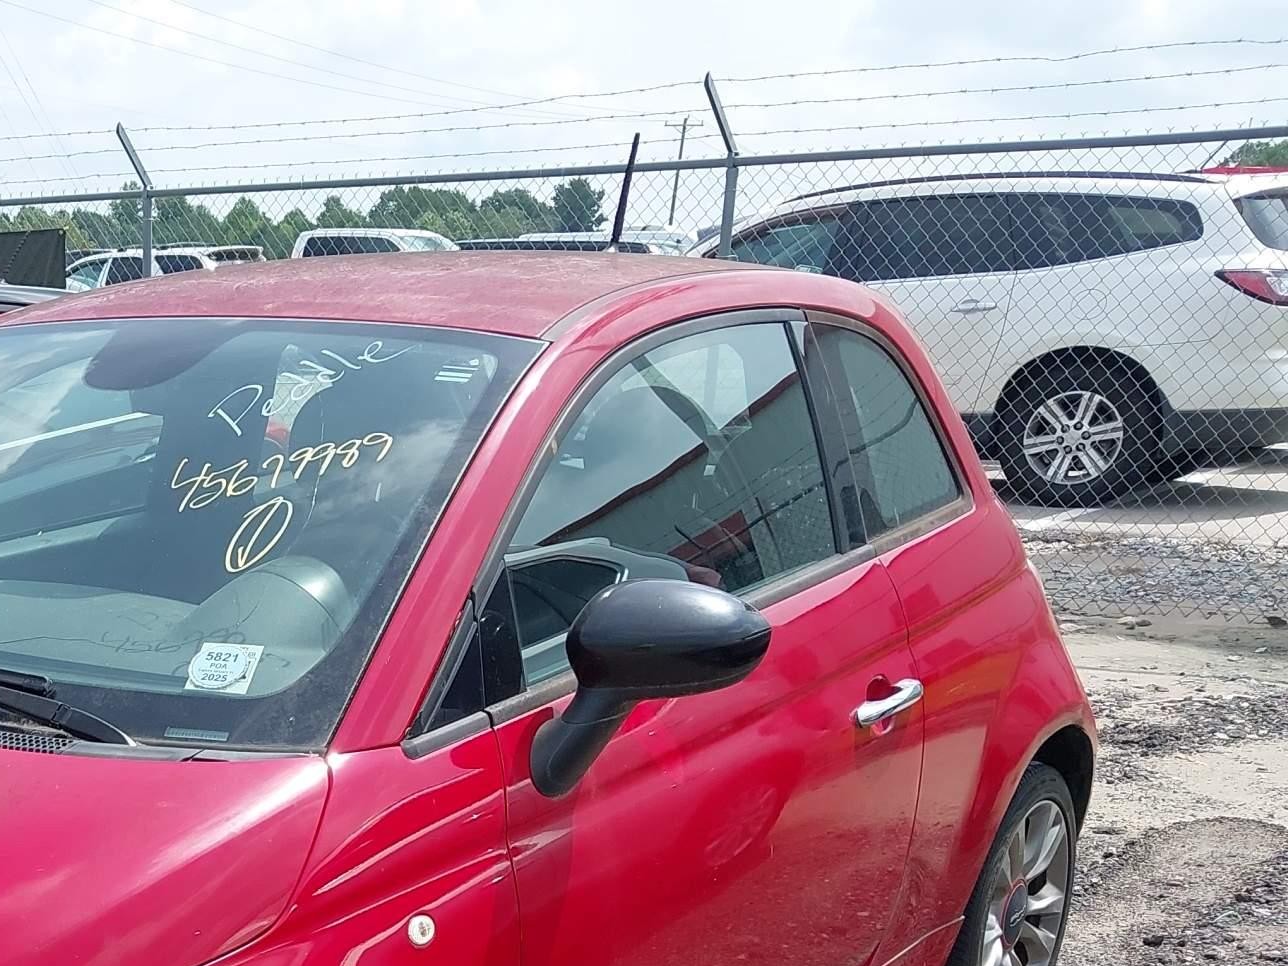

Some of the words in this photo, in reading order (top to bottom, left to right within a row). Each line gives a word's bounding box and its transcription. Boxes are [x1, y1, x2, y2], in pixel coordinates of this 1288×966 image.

[171, 432, 394, 513] 45679989
[205, 651, 239, 663] 5821
[201, 673, 228, 682] 2025
